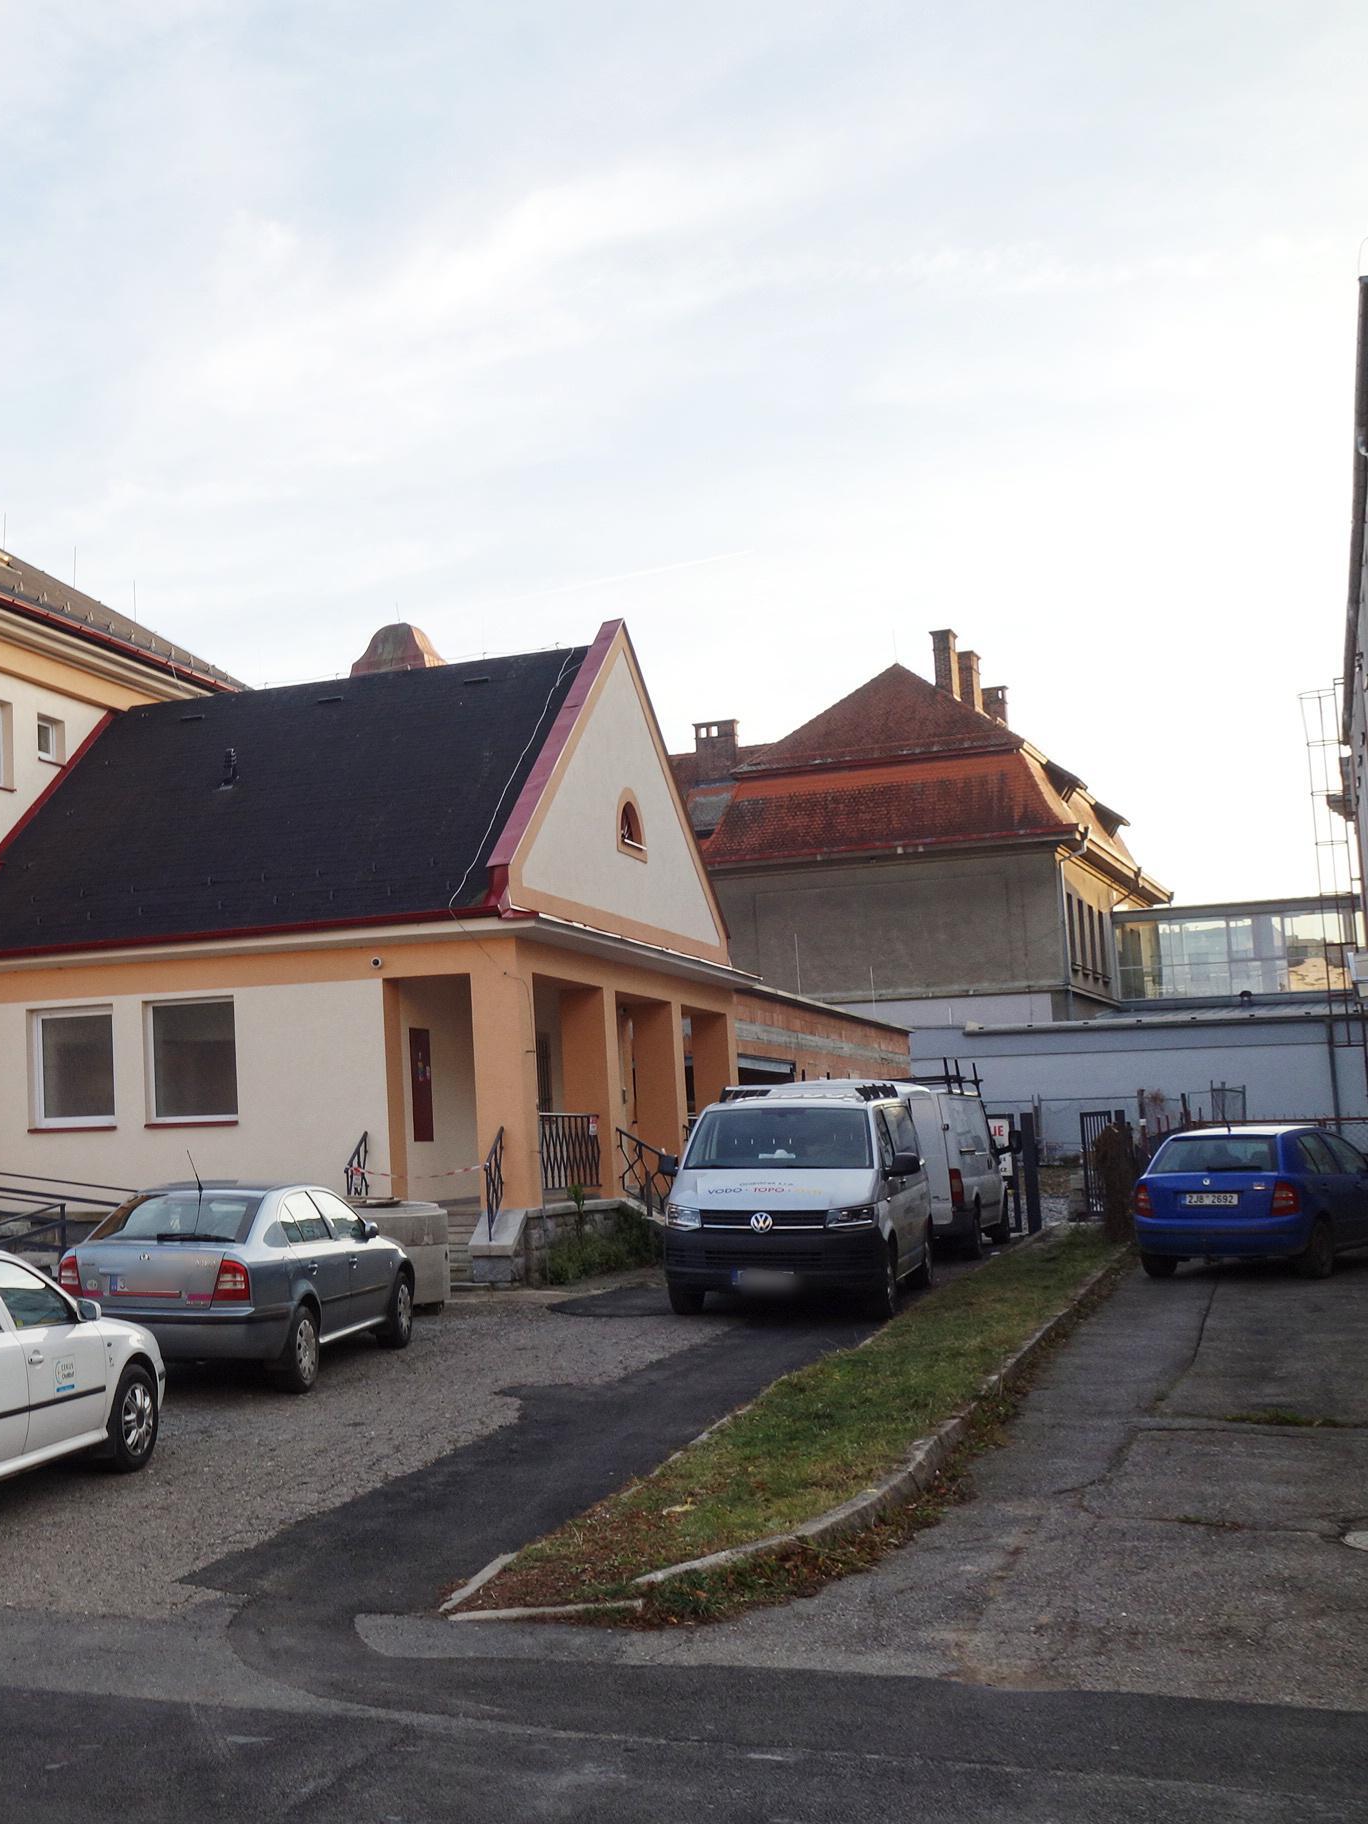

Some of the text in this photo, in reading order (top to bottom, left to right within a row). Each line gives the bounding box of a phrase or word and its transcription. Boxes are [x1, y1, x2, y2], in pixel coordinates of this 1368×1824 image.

[708, 1187, 743, 1195] VODO
[753, 1186, 785, 1194] TOPO
[1211, 1194, 1234, 1204] 2692
